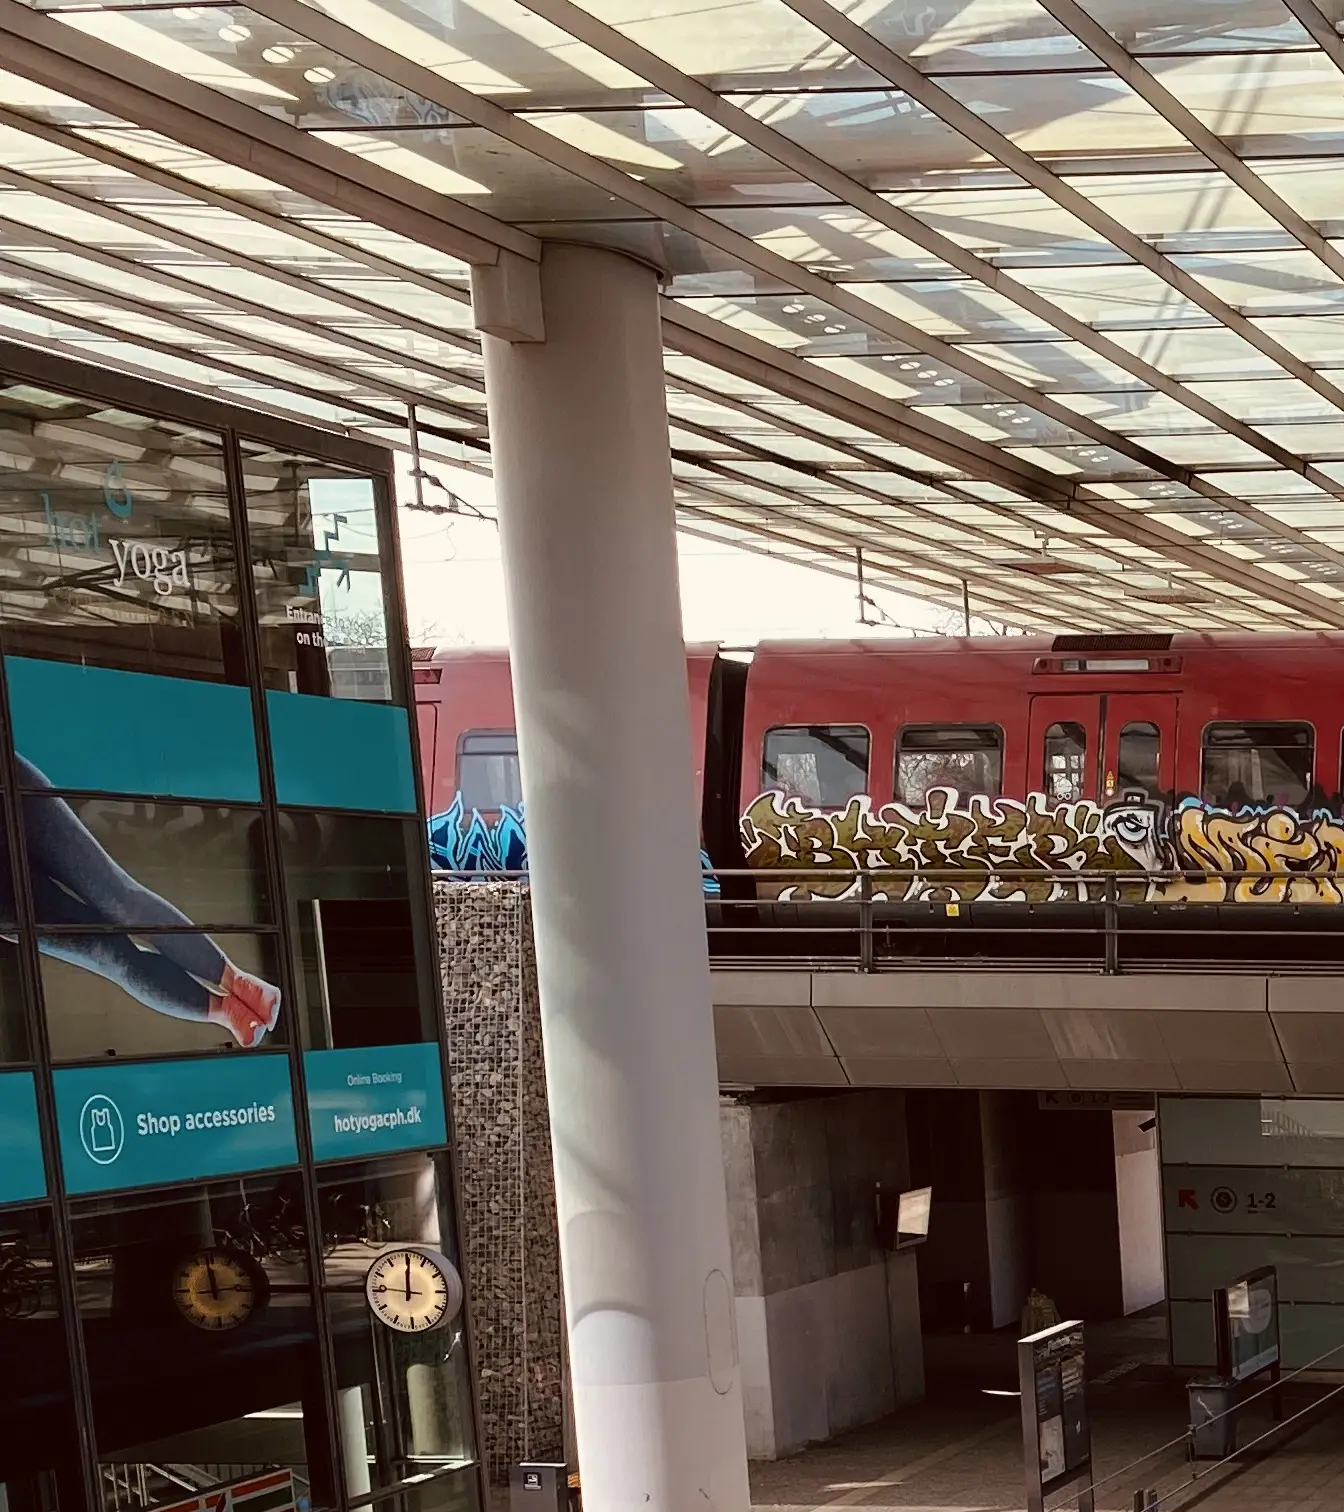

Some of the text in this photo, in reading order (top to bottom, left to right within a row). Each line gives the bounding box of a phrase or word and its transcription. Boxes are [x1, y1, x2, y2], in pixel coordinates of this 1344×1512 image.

[108, 538, 193, 596] yoga
[296, 632, 311, 646] on
[347, 1071, 403, 1087] Online Booking
[137, 1101, 276, 1137] Shop accessories
[334, 1105, 422, 1134] hotyogacph.dk
[1247, 1192, 1277, 1209] 1-2
